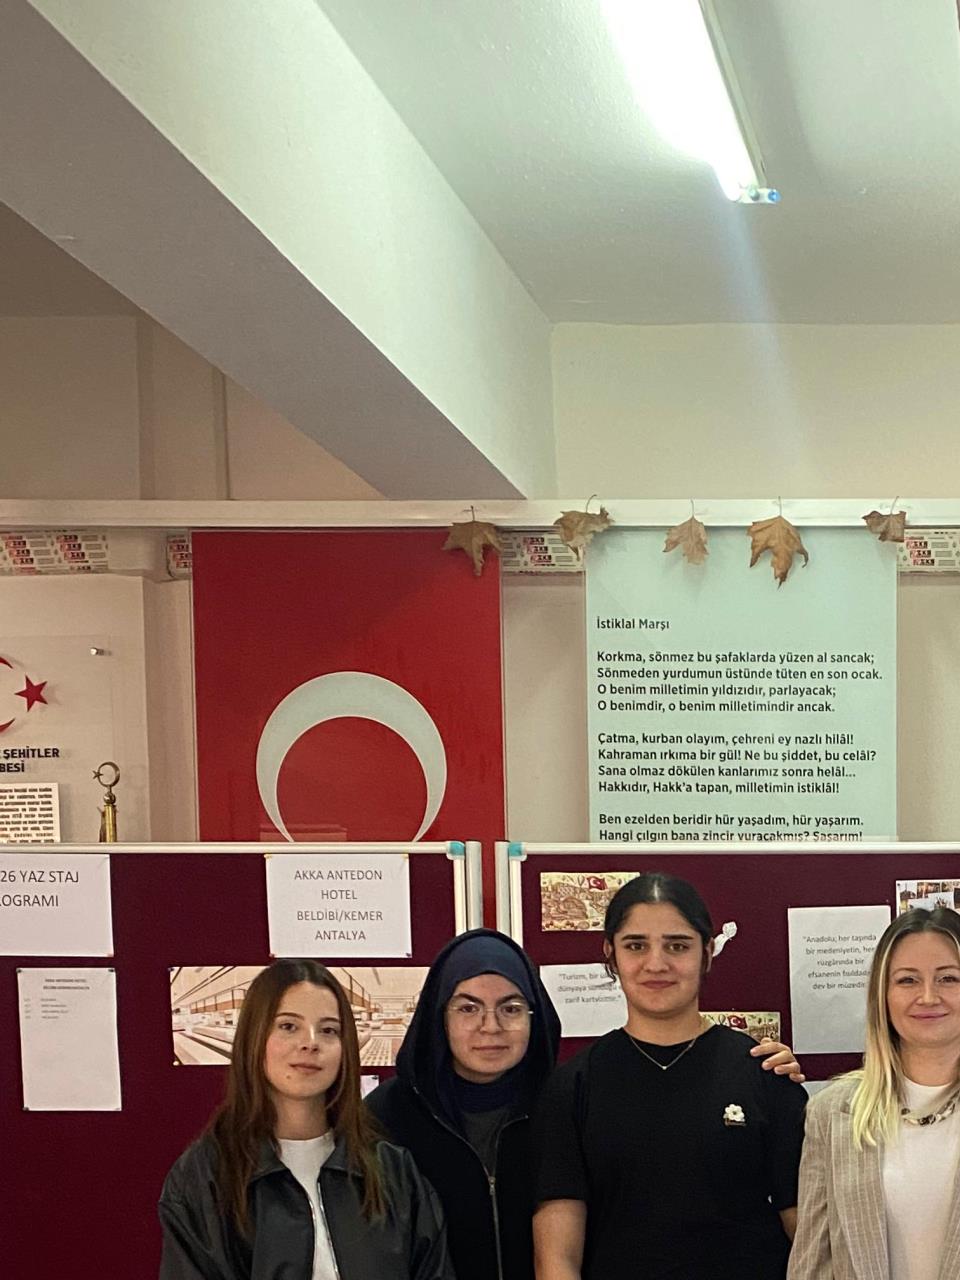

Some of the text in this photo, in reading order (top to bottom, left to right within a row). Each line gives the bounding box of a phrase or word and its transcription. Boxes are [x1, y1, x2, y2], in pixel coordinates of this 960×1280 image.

[597, 616, 670, 631] İstiklal Marşı
[597, 650, 874, 665] Korkma, sönmez bu şafaklarda yüzen al sancak;
[597, 667, 882, 680] Sönmeden yurdumun üstünde tüten en son ocak.
[597, 683, 836, 698] O benim milletimin yıldızıdır, parlayacak;
[597, 700, 835, 713] O benimdir, o benim milletimindir ancak.
[598, 732, 854, 746] Çatma, kurban olayım, çehreni ey nazlı hilâl!
[3, 745, 60, 760] ŞEHİTLER
[598, 748, 876, 763] Kahraman ırkıma bir gül! Ne bu şiddet, bu celâl?
[598, 765, 626, 776] Sana
[629, 765, 665, 776] olmaz
[668, 765, 715, 776] dökülen
[718, 765, 778, 777] kanlarımız
[782, 768, 814, 777] sonra
[598, 781, 650, 794] Hakkıdır,
[695, 782, 732, 795] tapan,
[735, 782, 794, 793] milletimin
[599, 814, 864, 828] Ben ezelden beridir hür yaşadım, hür yaşarım.
[599, 829, 735, 843] Hangi çılgın bana zincir
[0, 870, 79, 883] 26 YAZ STAJ
[294, 870, 382, 880] AKKA ANTEDON
[0, 894, 59, 907] OGRAMI
[321, 889, 358, 900] HOTEL
[314, 930, 366, 941] ANTALYA
